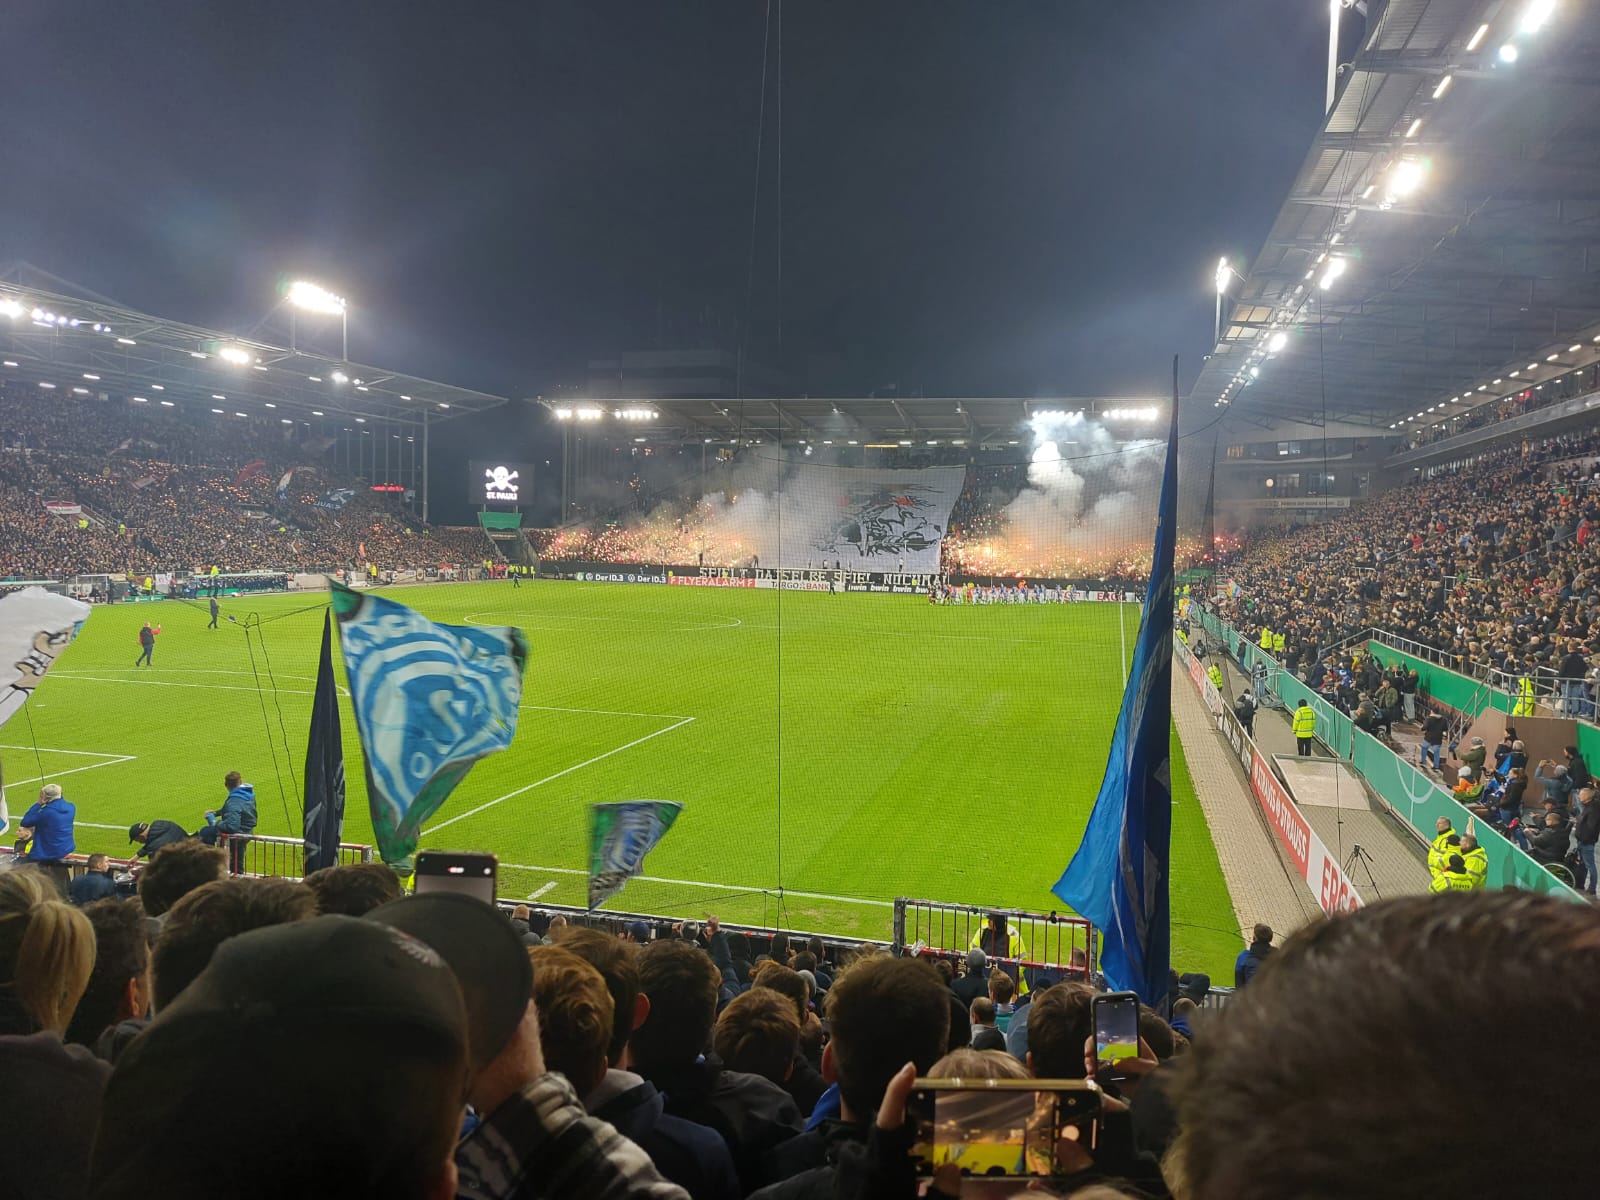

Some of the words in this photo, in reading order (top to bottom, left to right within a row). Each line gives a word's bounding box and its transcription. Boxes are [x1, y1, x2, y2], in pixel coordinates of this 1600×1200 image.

[497, 492, 518, 500] PAULI
[609, 574, 624, 582] ID.3
[637, 575, 650, 583] Der
[834, 571, 875, 584] SPIEL
[678, 576, 745, 588] FLYERALARM
[871, 584, 889, 592] bwin
[893, 585, 912, 593] bwin
[1280, 802, 1307, 863] STRAUSS
[1321, 855, 1358, 912] ERG
